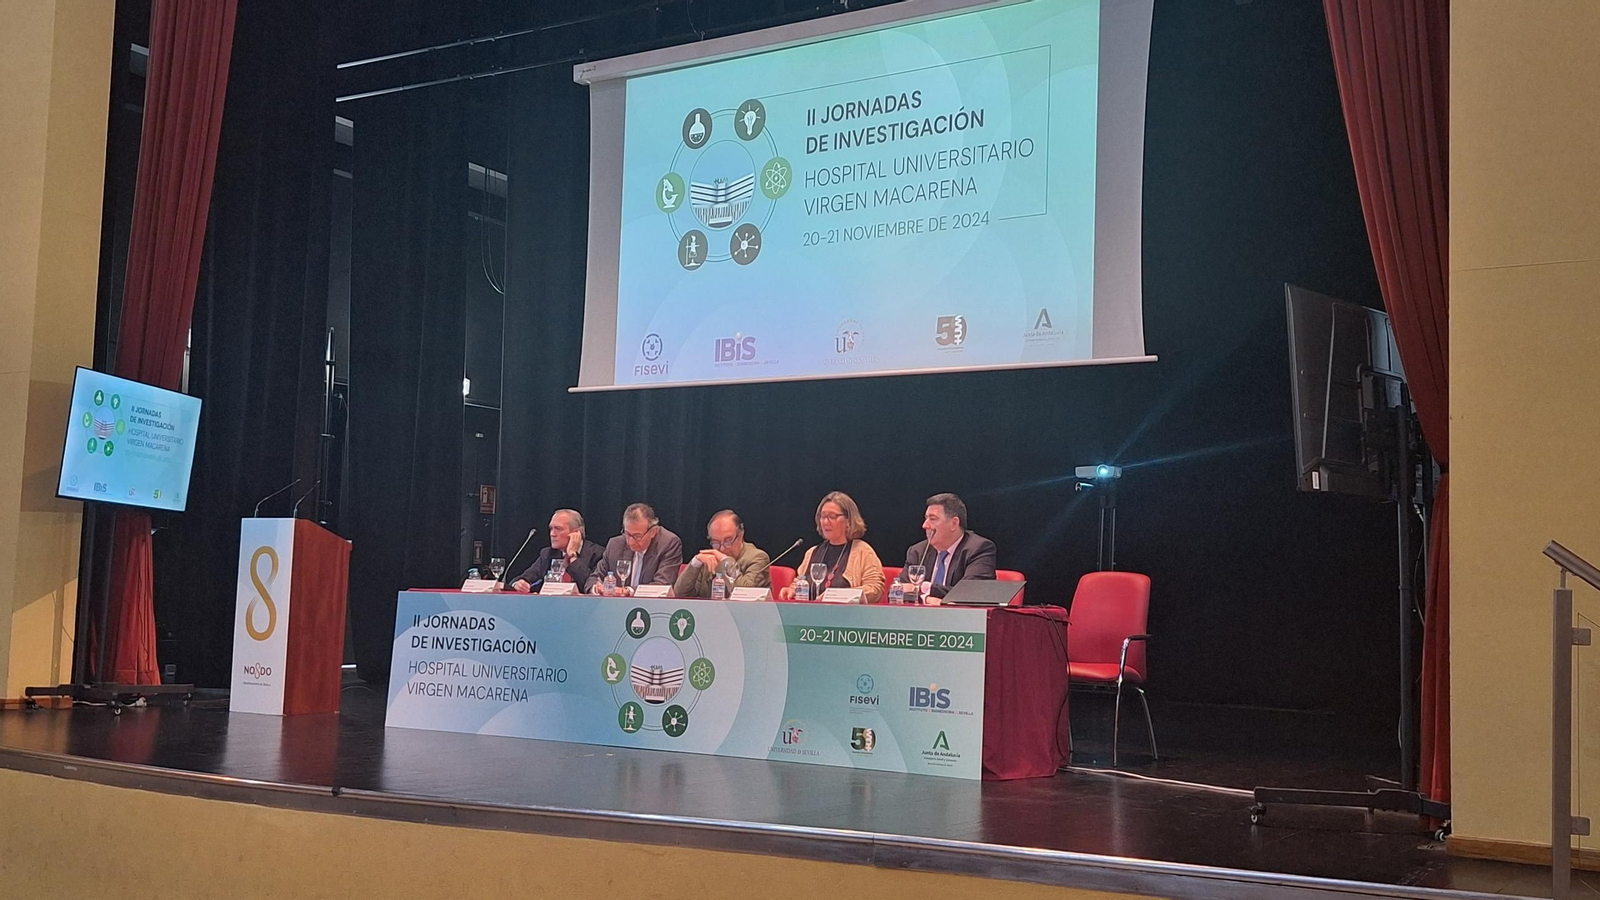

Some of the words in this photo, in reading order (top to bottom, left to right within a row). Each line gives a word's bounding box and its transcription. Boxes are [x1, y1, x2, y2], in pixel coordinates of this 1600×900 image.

[806, 108, 816, 126] II
[821, 90, 922, 124] JORNADAS
[806, 134, 828, 154] DE
[834, 105, 985, 150] INVESTIGACIÓN
[804, 160, 886, 188] HOSPITAL
[893, 138, 1034, 176] UNIVERSITARIO
[804, 191, 867, 216] VIRGEN
[874, 176, 978, 208] MACARENA
[802, 229, 839, 246] 20-21
[843, 219, 924, 242] NOVIEMBRE
[929, 216, 948, 231] DE
[952, 210, 990, 230] 2024
[135, 406, 162, 418] JORNADAS
[128, 428, 150, 438] HOSPITAL
[151, 433, 184, 445] UNIVERSITARIO
[145, 441, 170, 452] MACARENA
[413, 614, 420, 628] II
[424, 615, 496, 631] JORNADAS
[411, 635, 428, 649] DE
[431, 636, 537, 655] INVESTIGACIÓN
[800, 628, 835, 643] 20-21
[838, 630, 913, 647] NOVIEMBRE
[917, 633, 935, 647] DE
[939, 634, 975, 649] 2024
[408, 660, 468, 678] HOSPITAL
[472, 664, 568, 684] UNIVERSITARIO
[406, 682, 453, 698] VIRGEN
[456, 685, 529, 703] MACARENA
